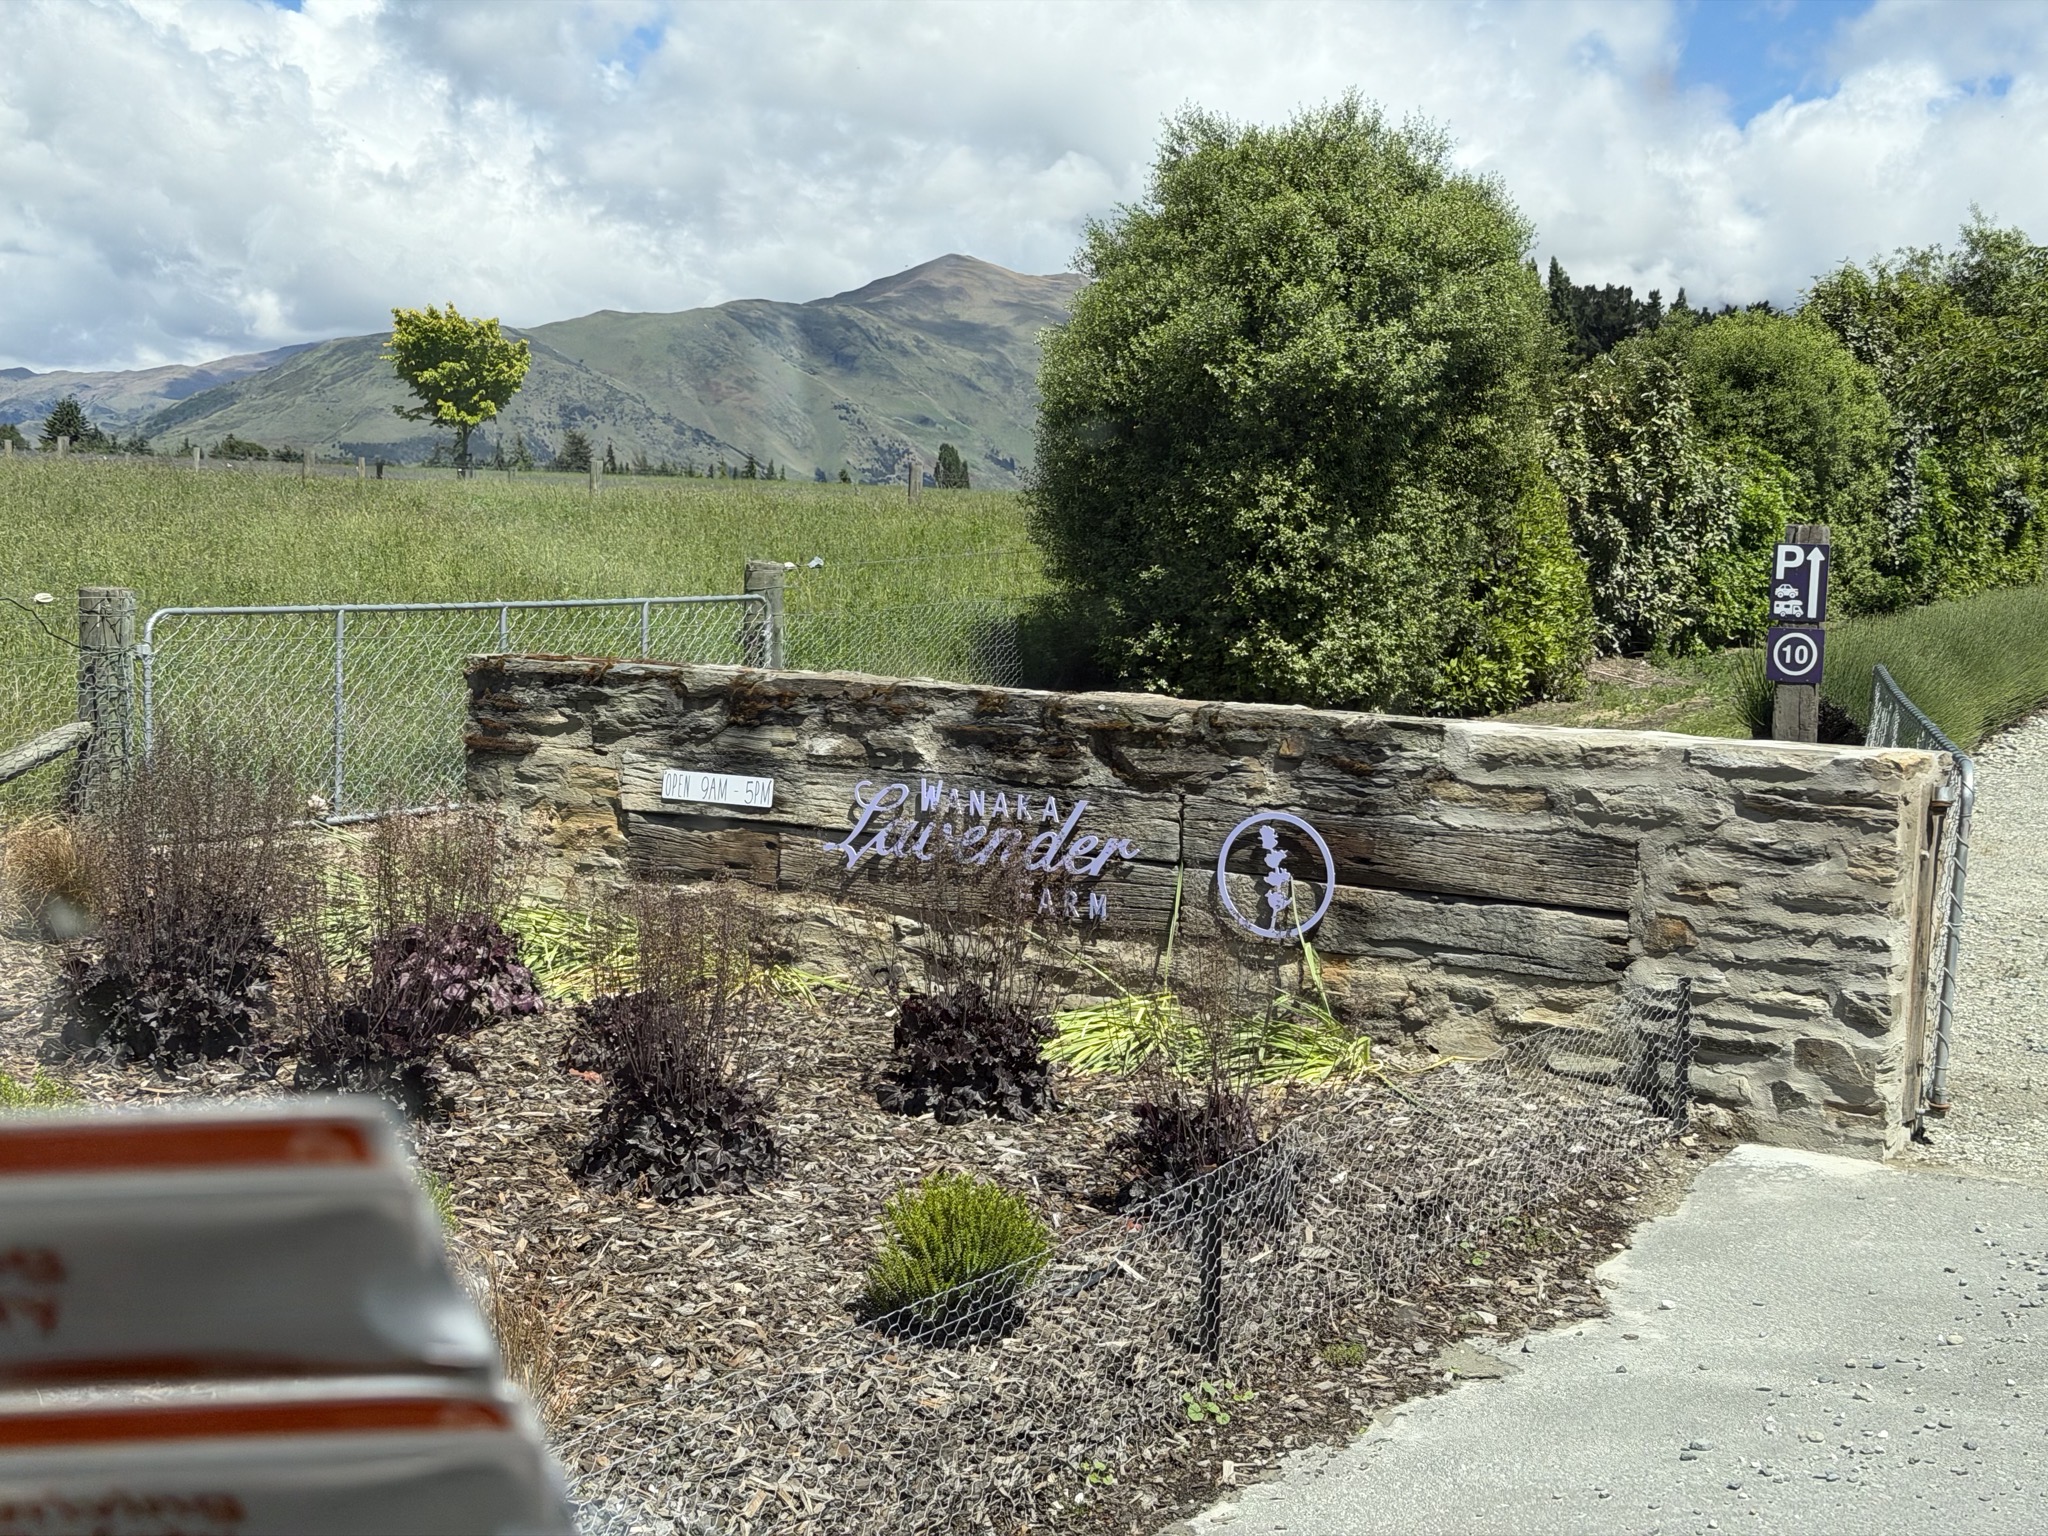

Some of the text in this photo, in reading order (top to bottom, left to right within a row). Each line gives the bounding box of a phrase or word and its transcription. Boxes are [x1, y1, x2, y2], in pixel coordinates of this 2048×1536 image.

[1775, 544, 1805, 580] P
[1782, 644, 1809, 665] 10
[664, 773, 691, 798] OPEN
[700, 775, 728, 802] 9AM
[743, 780, 772, 805] 5PM
[920, 778, 1059, 823] WANAKA
